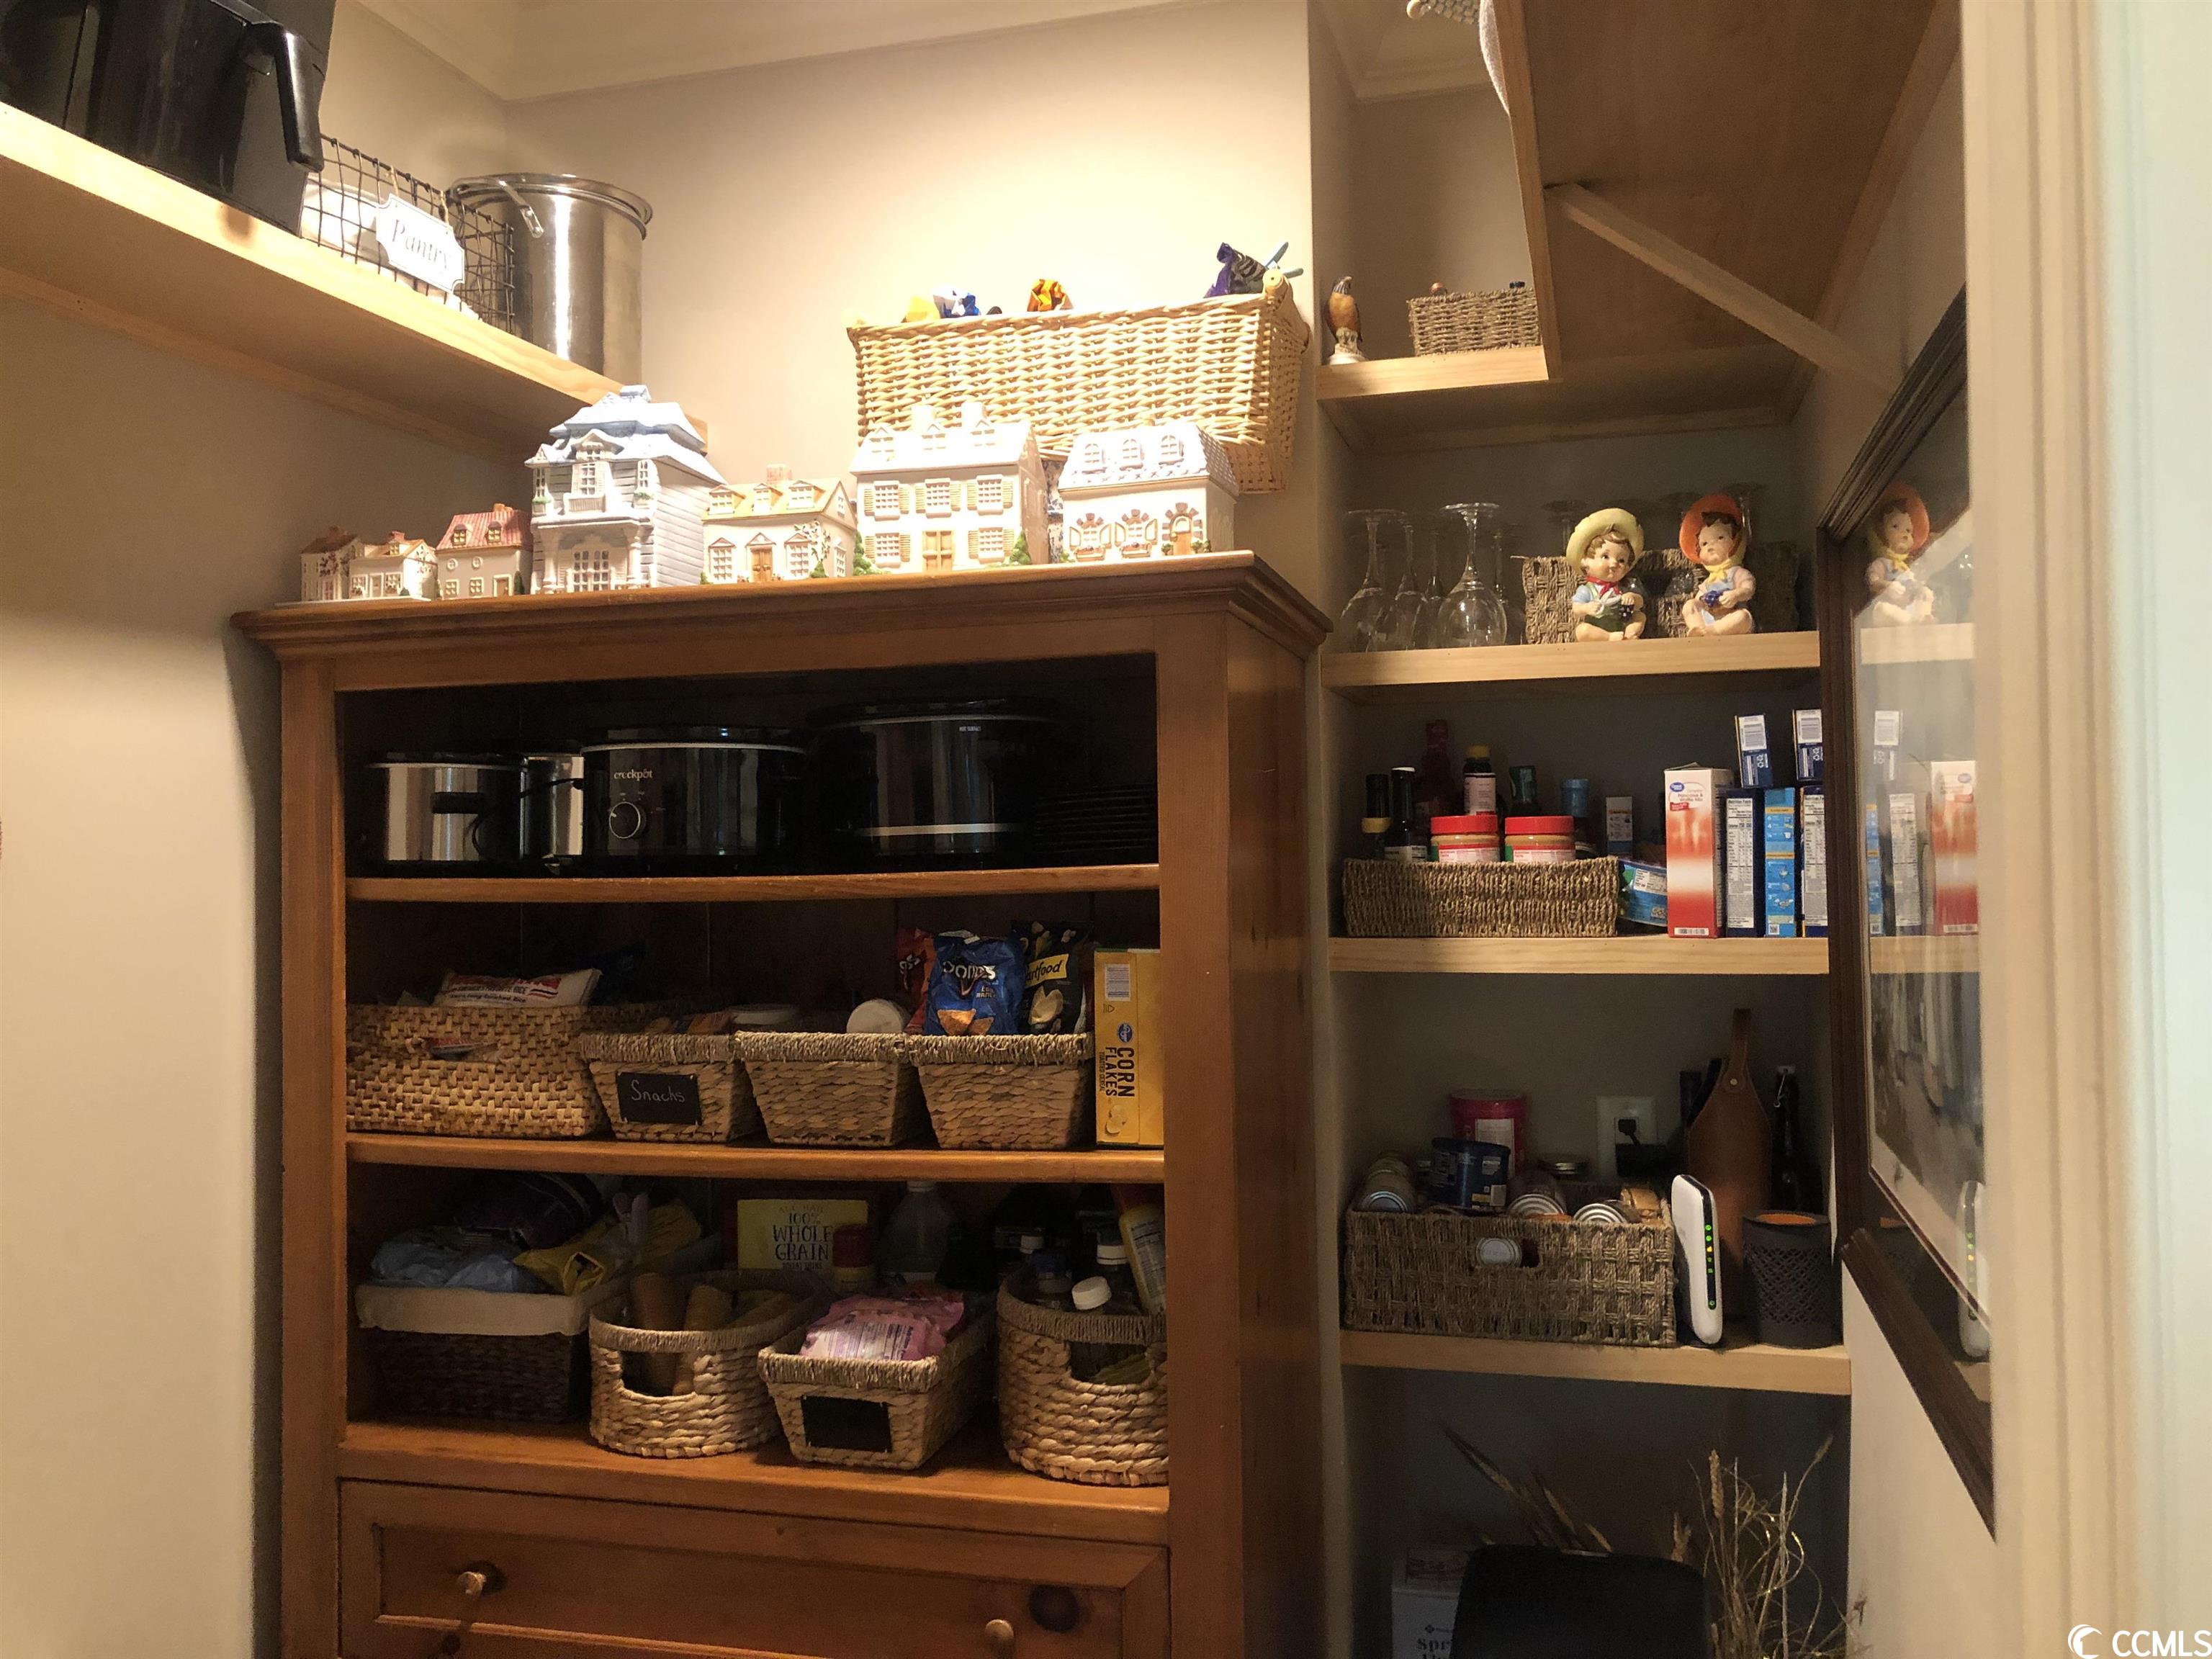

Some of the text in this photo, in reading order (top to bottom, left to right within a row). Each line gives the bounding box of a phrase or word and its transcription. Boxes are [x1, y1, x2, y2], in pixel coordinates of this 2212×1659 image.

[392, 218, 450, 274] Pantry
[1025, 960, 1064, 981] artfood
[1105, 1047, 1118, 1097] FLAKES
[1117, 1047, 1136, 1097] CORN
[631, 1079, 685, 1103] Snacks
[773, 1225, 833, 1242] WHOLE
[775, 1244, 829, 1261] GRAIN
